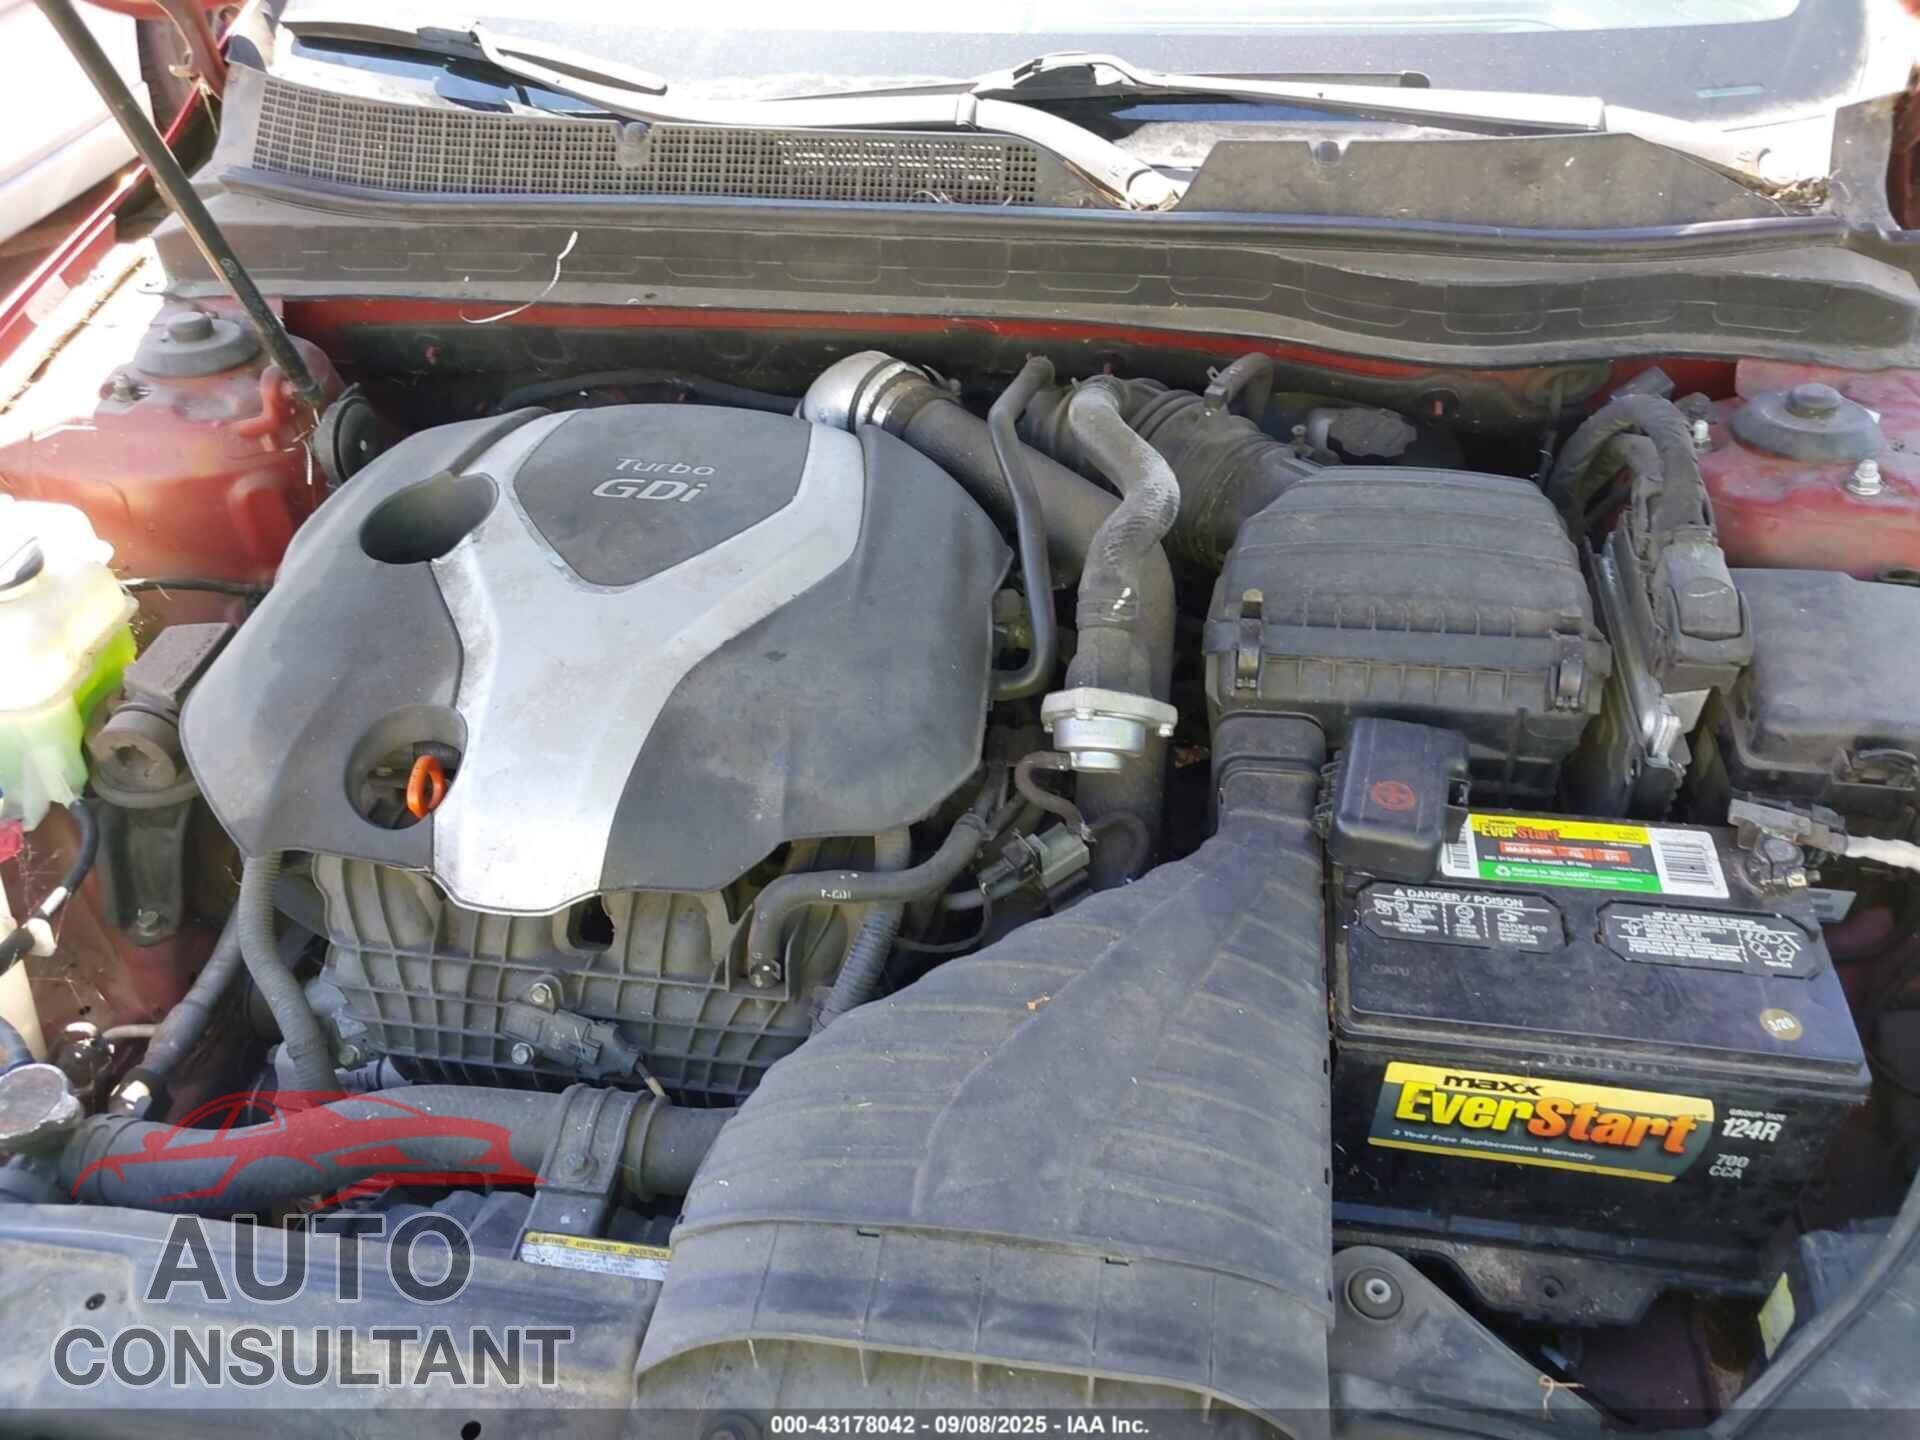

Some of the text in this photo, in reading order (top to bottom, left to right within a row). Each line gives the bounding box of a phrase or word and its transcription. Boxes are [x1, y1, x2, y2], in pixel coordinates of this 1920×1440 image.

[615, 457, 716, 476] Turbo
[591, 478, 708, 502] GDi
[1481, 822, 1560, 842] EverStart
[1406, 889, 1460, 902] DANGER
[1473, 895, 1524, 907] POISON
[1443, 1074, 1543, 1096] maxx
[1394, 1080, 1698, 1155] EverStart
[1721, 1117, 1782, 1142] 124R
[1404, 1130, 1428, 1140] Year
[1431, 1134, 1457, 1144] Free
[1460, 1137, 1538, 1153] Replacement
[1541, 1147, 1597, 1161] Warranty
[1715, 1153, 1750, 1168] 700
[1708, 1165, 1743, 1179] CCA
